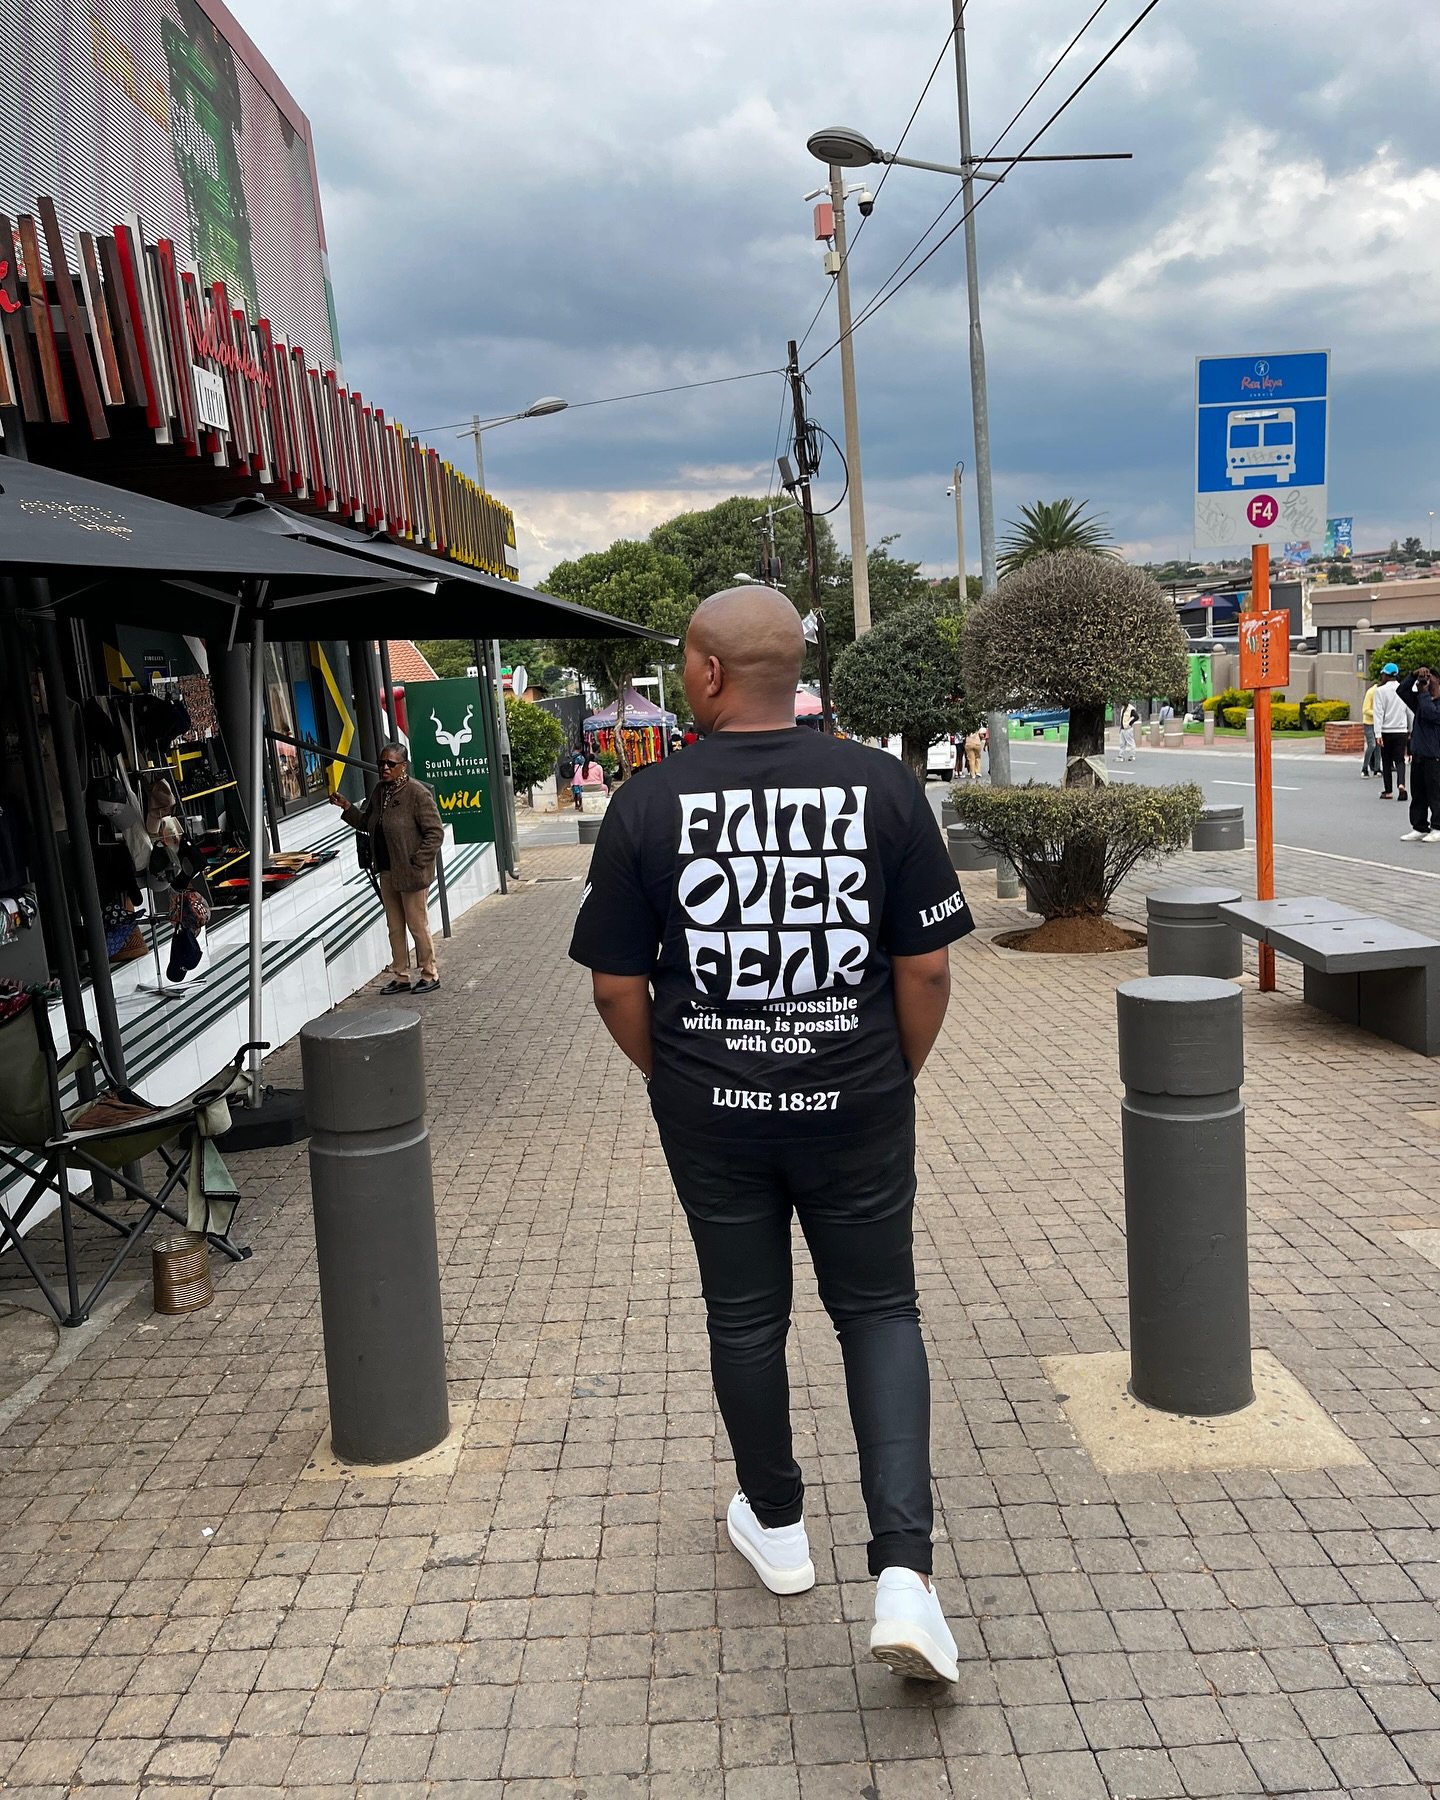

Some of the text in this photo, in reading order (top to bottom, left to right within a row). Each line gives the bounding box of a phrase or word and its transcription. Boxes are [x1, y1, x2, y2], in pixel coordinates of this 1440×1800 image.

[1252, 501, 1273, 521] F4
[425, 757, 451, 770] South
[426, 769, 463, 779] NATIONAL
[438, 789, 482, 811] Wild
[678, 785, 868, 855] FAITH
[678, 855, 870, 926] OVER
[918, 890, 964, 928] LUKE
[684, 928, 870, 1000] FEAR
[682, 1012, 859, 1036] with man, is possible
[725, 1034, 817, 1054] with GOD.
[712, 1086, 840, 1112] LUKE 18:27
